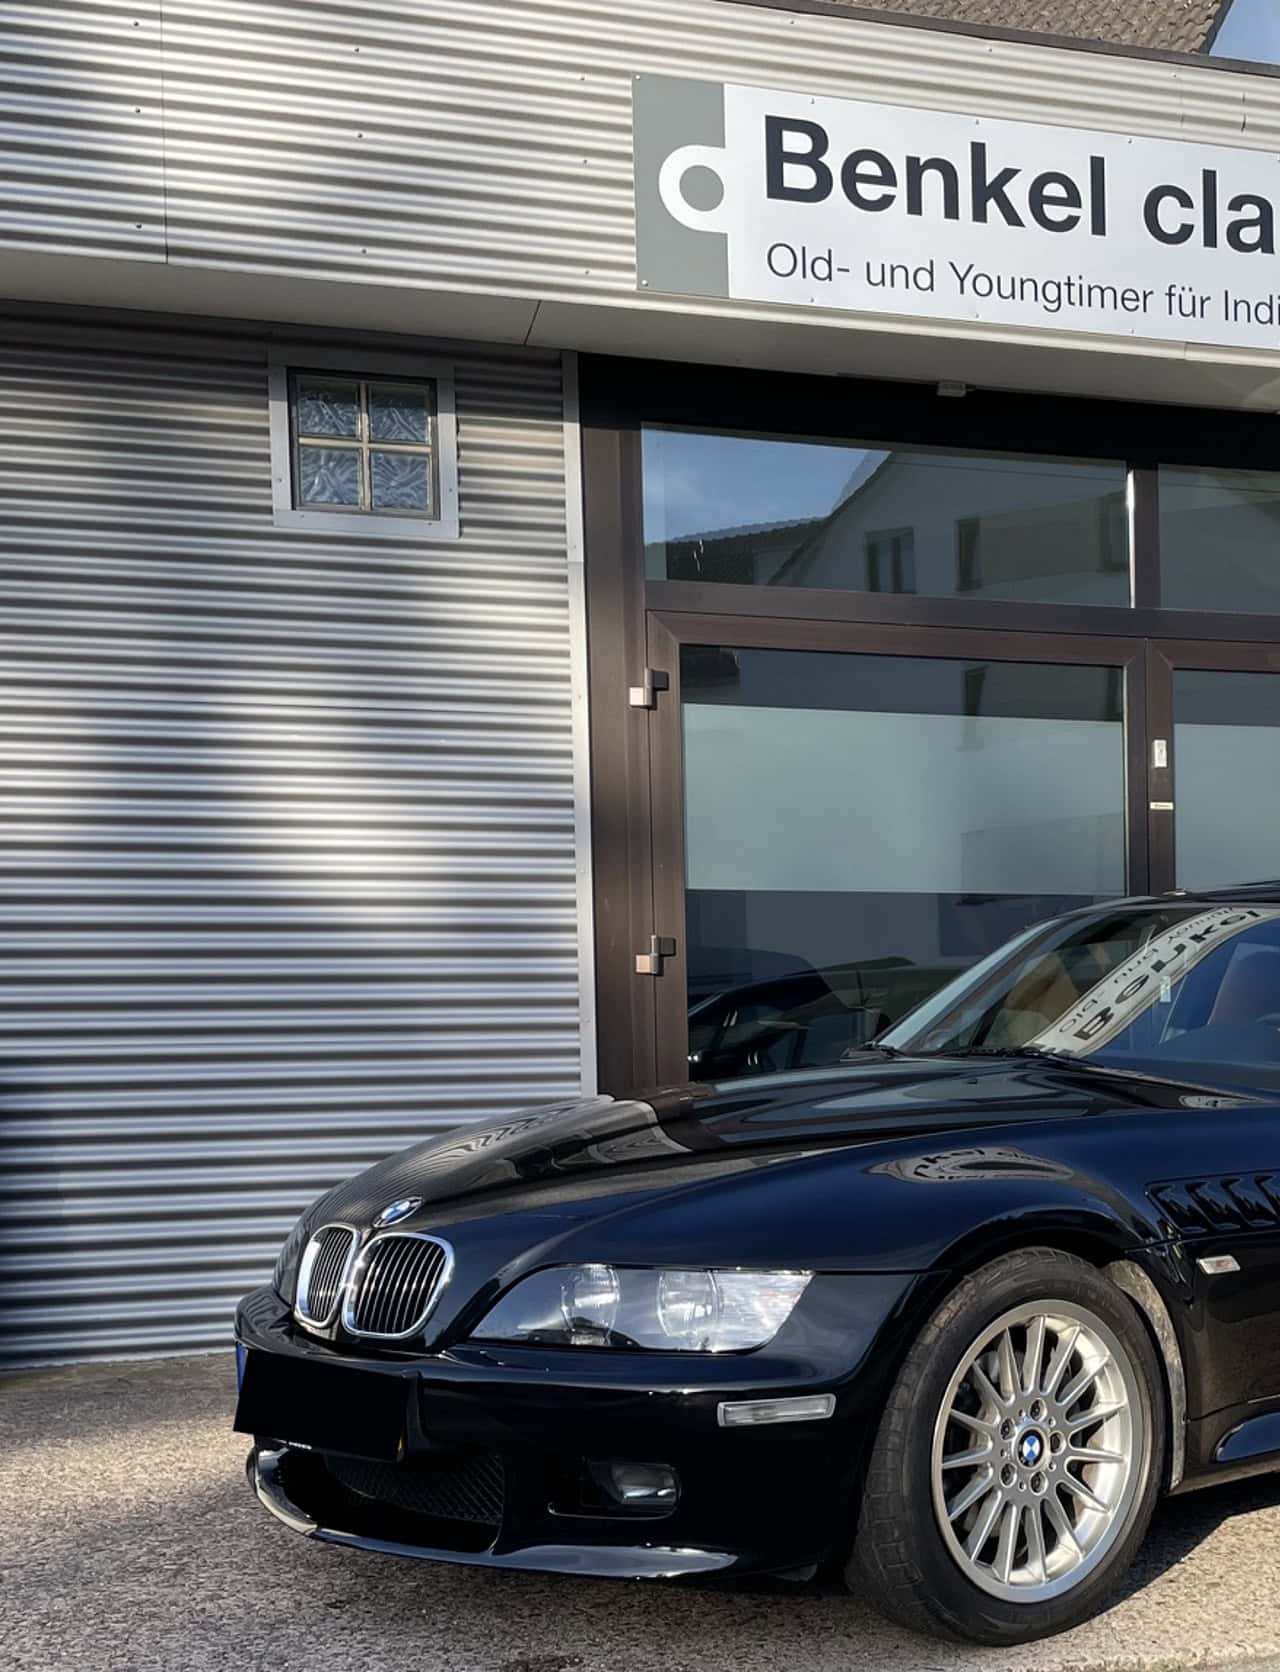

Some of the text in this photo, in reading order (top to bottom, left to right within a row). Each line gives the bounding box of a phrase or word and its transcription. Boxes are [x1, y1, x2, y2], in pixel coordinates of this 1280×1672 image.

[764, 114, 1106, 237] Benkel
[767, 242, 850, 282] Old-
[865, 259, 935, 292] und
[948, 261, 1154, 313] Youngtimer
[1165, 284, 1211, 318] für
